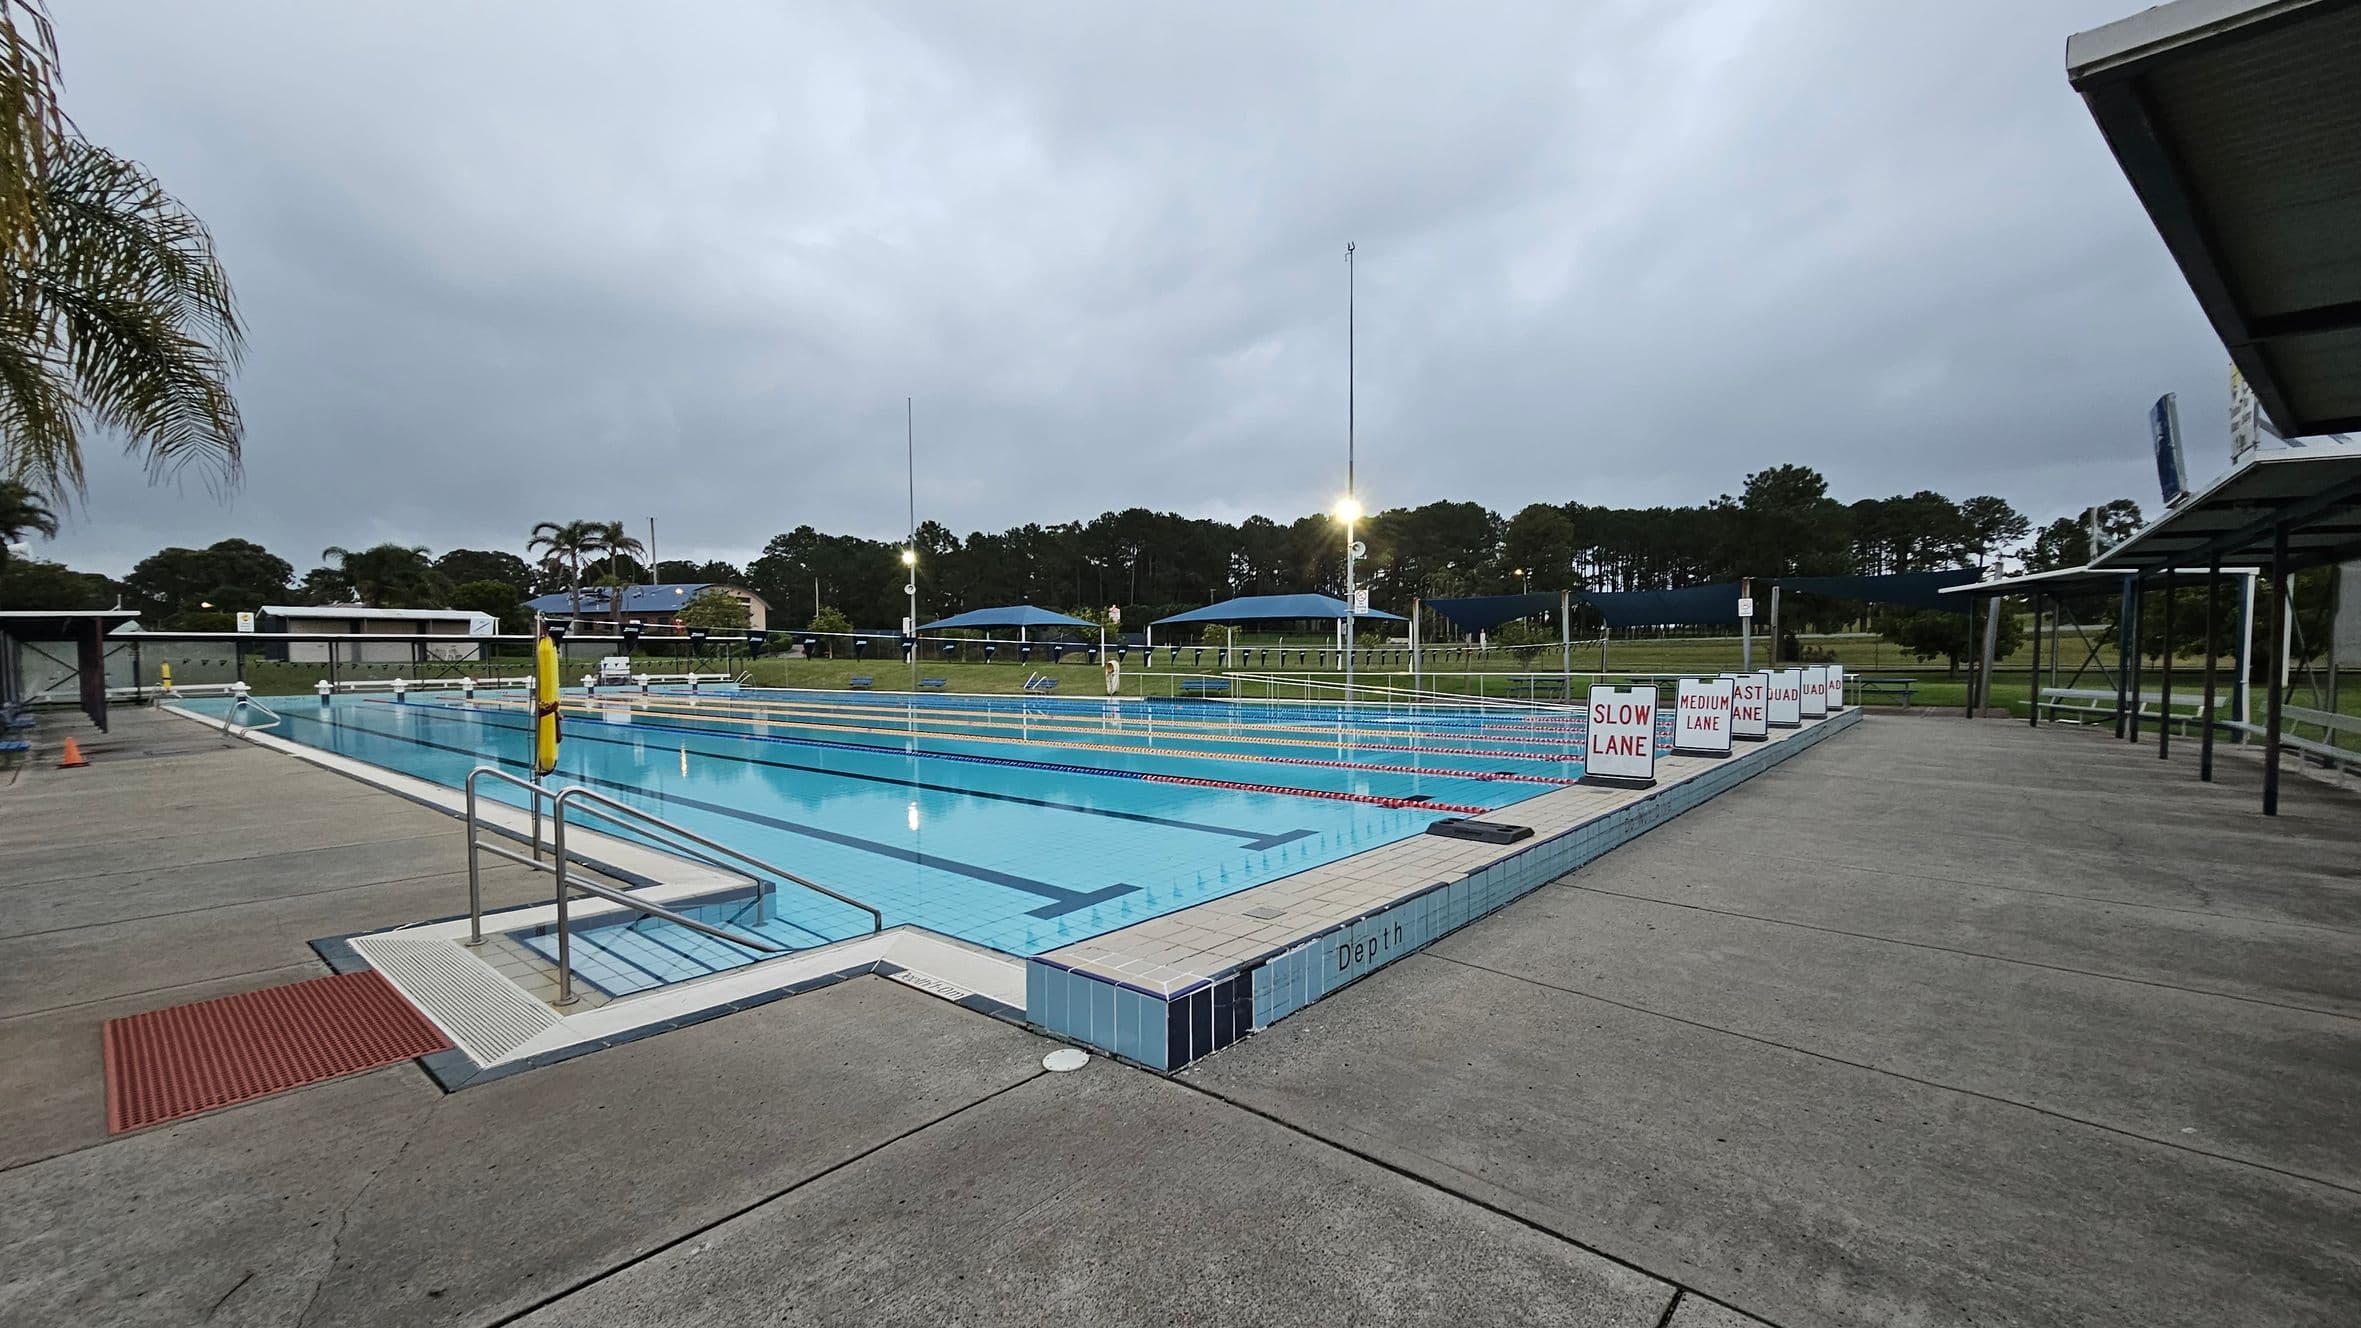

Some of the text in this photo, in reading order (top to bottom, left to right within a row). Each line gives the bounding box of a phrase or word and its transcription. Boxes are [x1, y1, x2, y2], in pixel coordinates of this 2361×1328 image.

[1734, 686, 1762, 700] AST
[1768, 688, 1798, 701] QUAD
[1803, 684, 1825, 695] UAD
[1680, 695, 1729, 710] MEDIUM
[1594, 704, 1651, 725] SLOW
[1733, 707, 1762, 721] ANE
[1687, 715, 1720, 731] LANE
[1593, 734, 1647, 756] LANE
[1339, 921, 1402, 971] Depth
